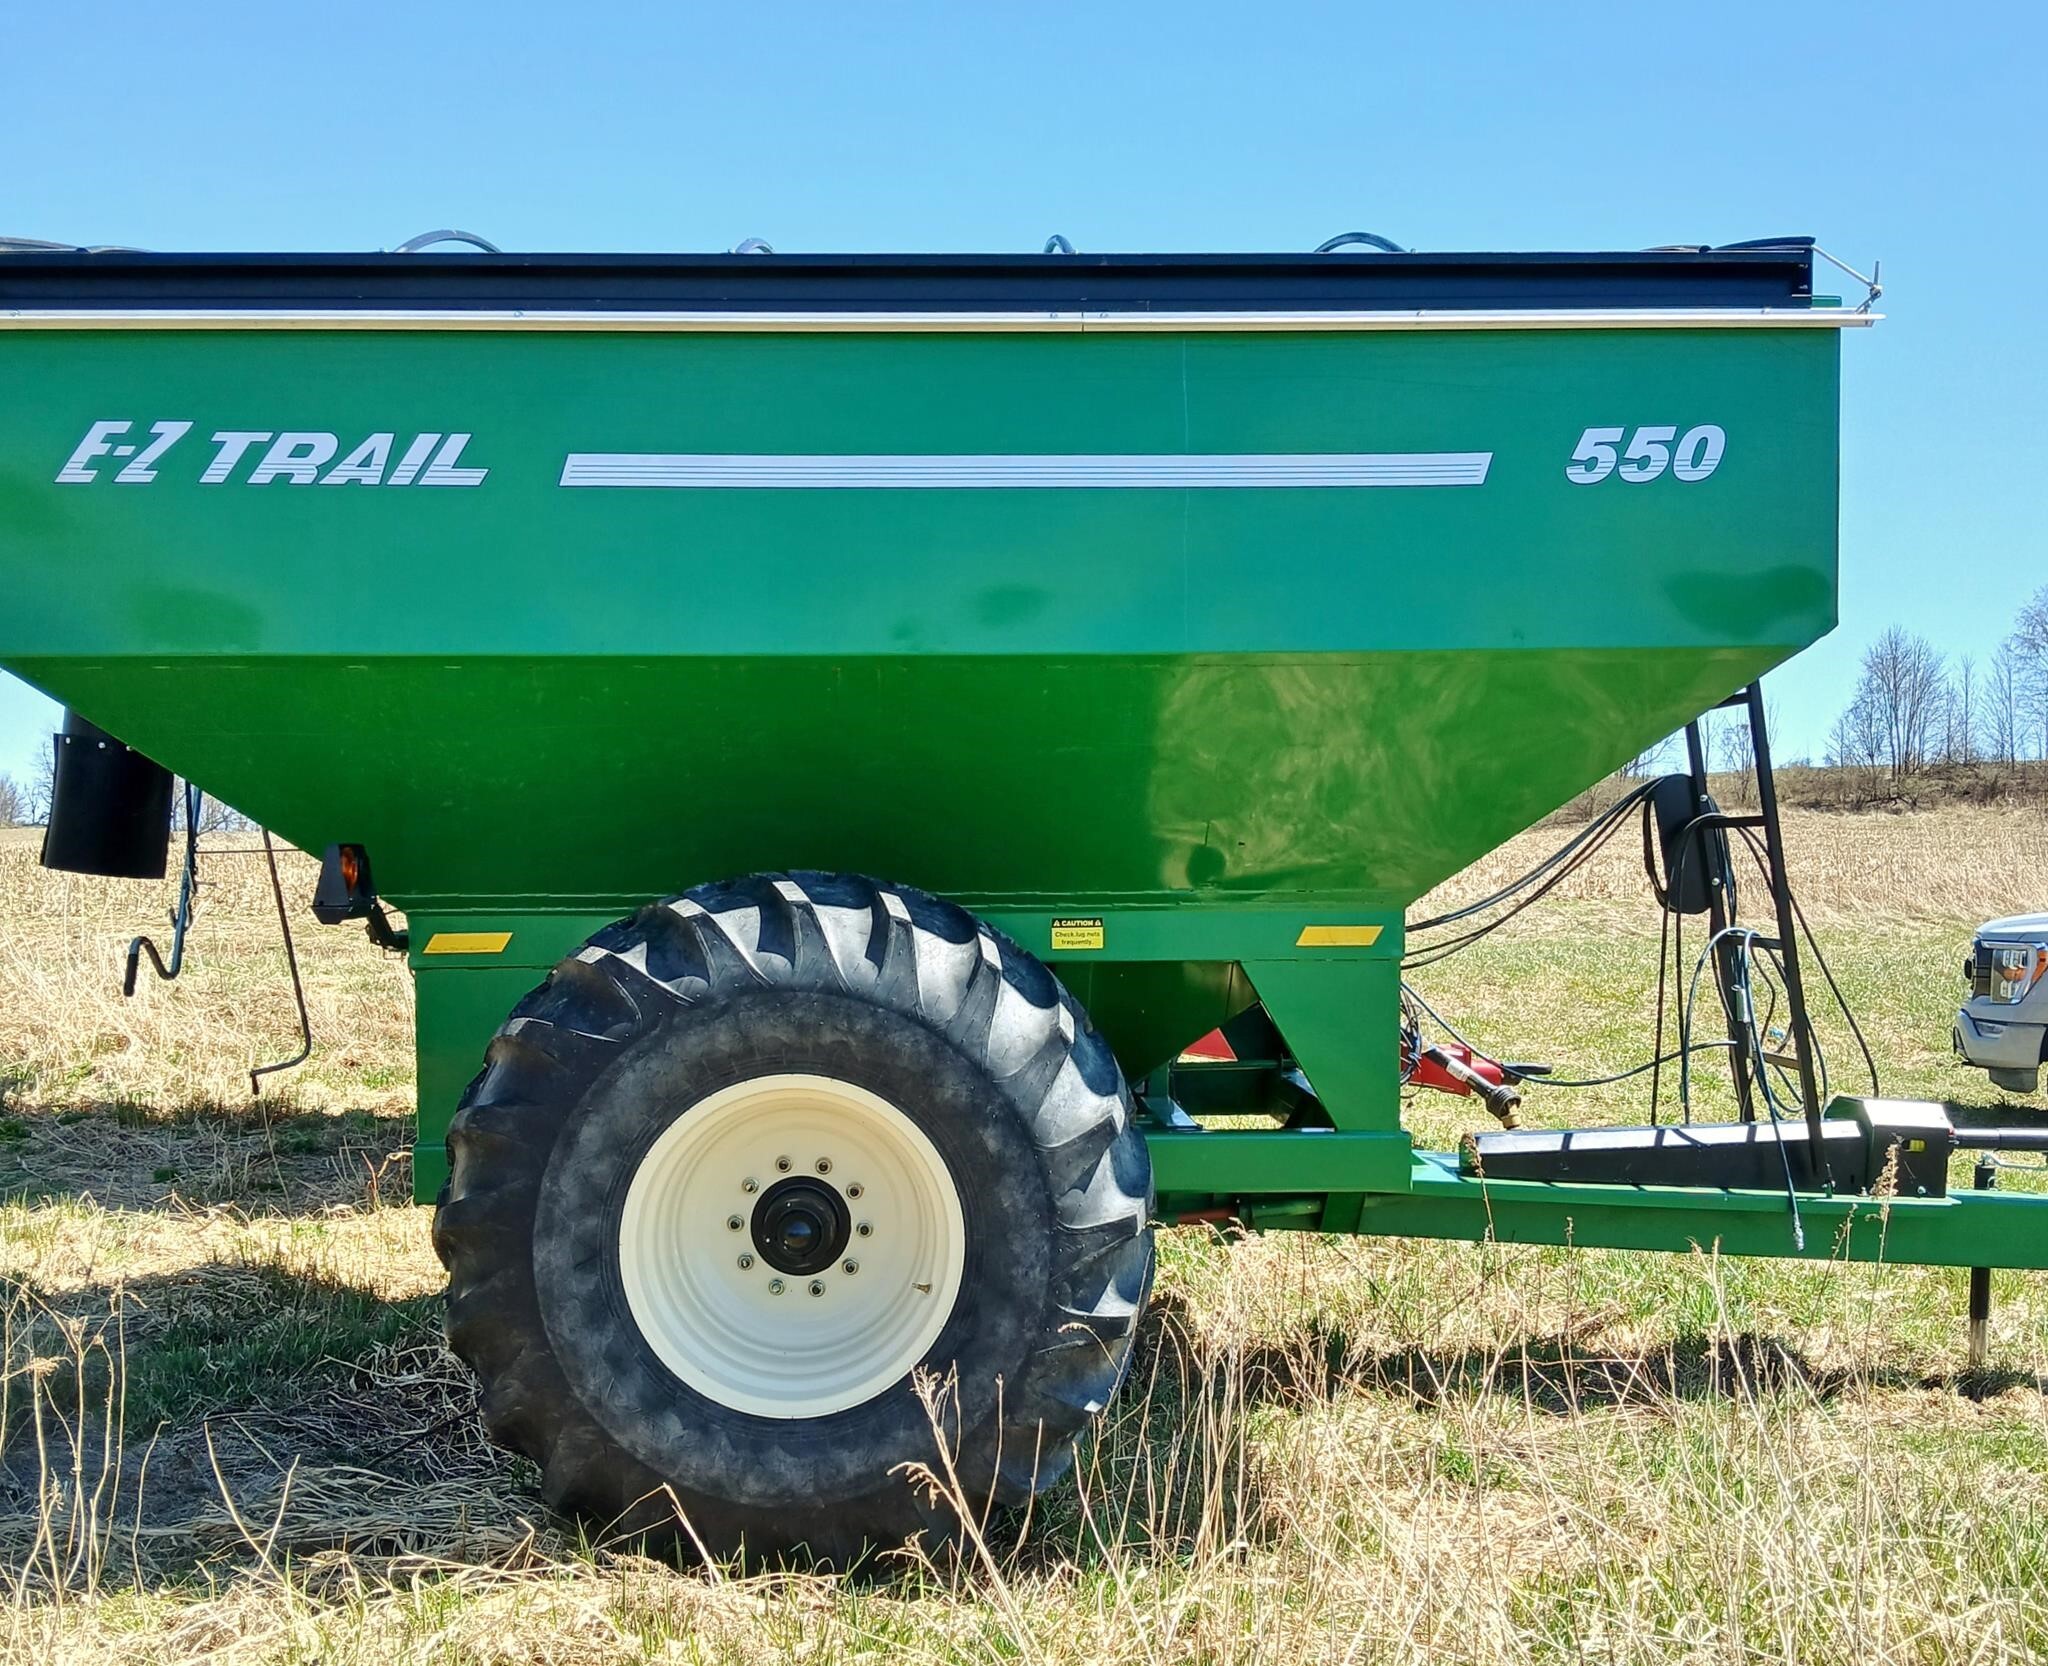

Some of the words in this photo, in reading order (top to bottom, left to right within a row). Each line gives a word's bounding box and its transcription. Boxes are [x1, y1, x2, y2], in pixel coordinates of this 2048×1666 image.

[54, 420, 195, 485] E-Z
[198, 431, 490, 487] TRAIL
[1564, 424, 1727, 485] 550
